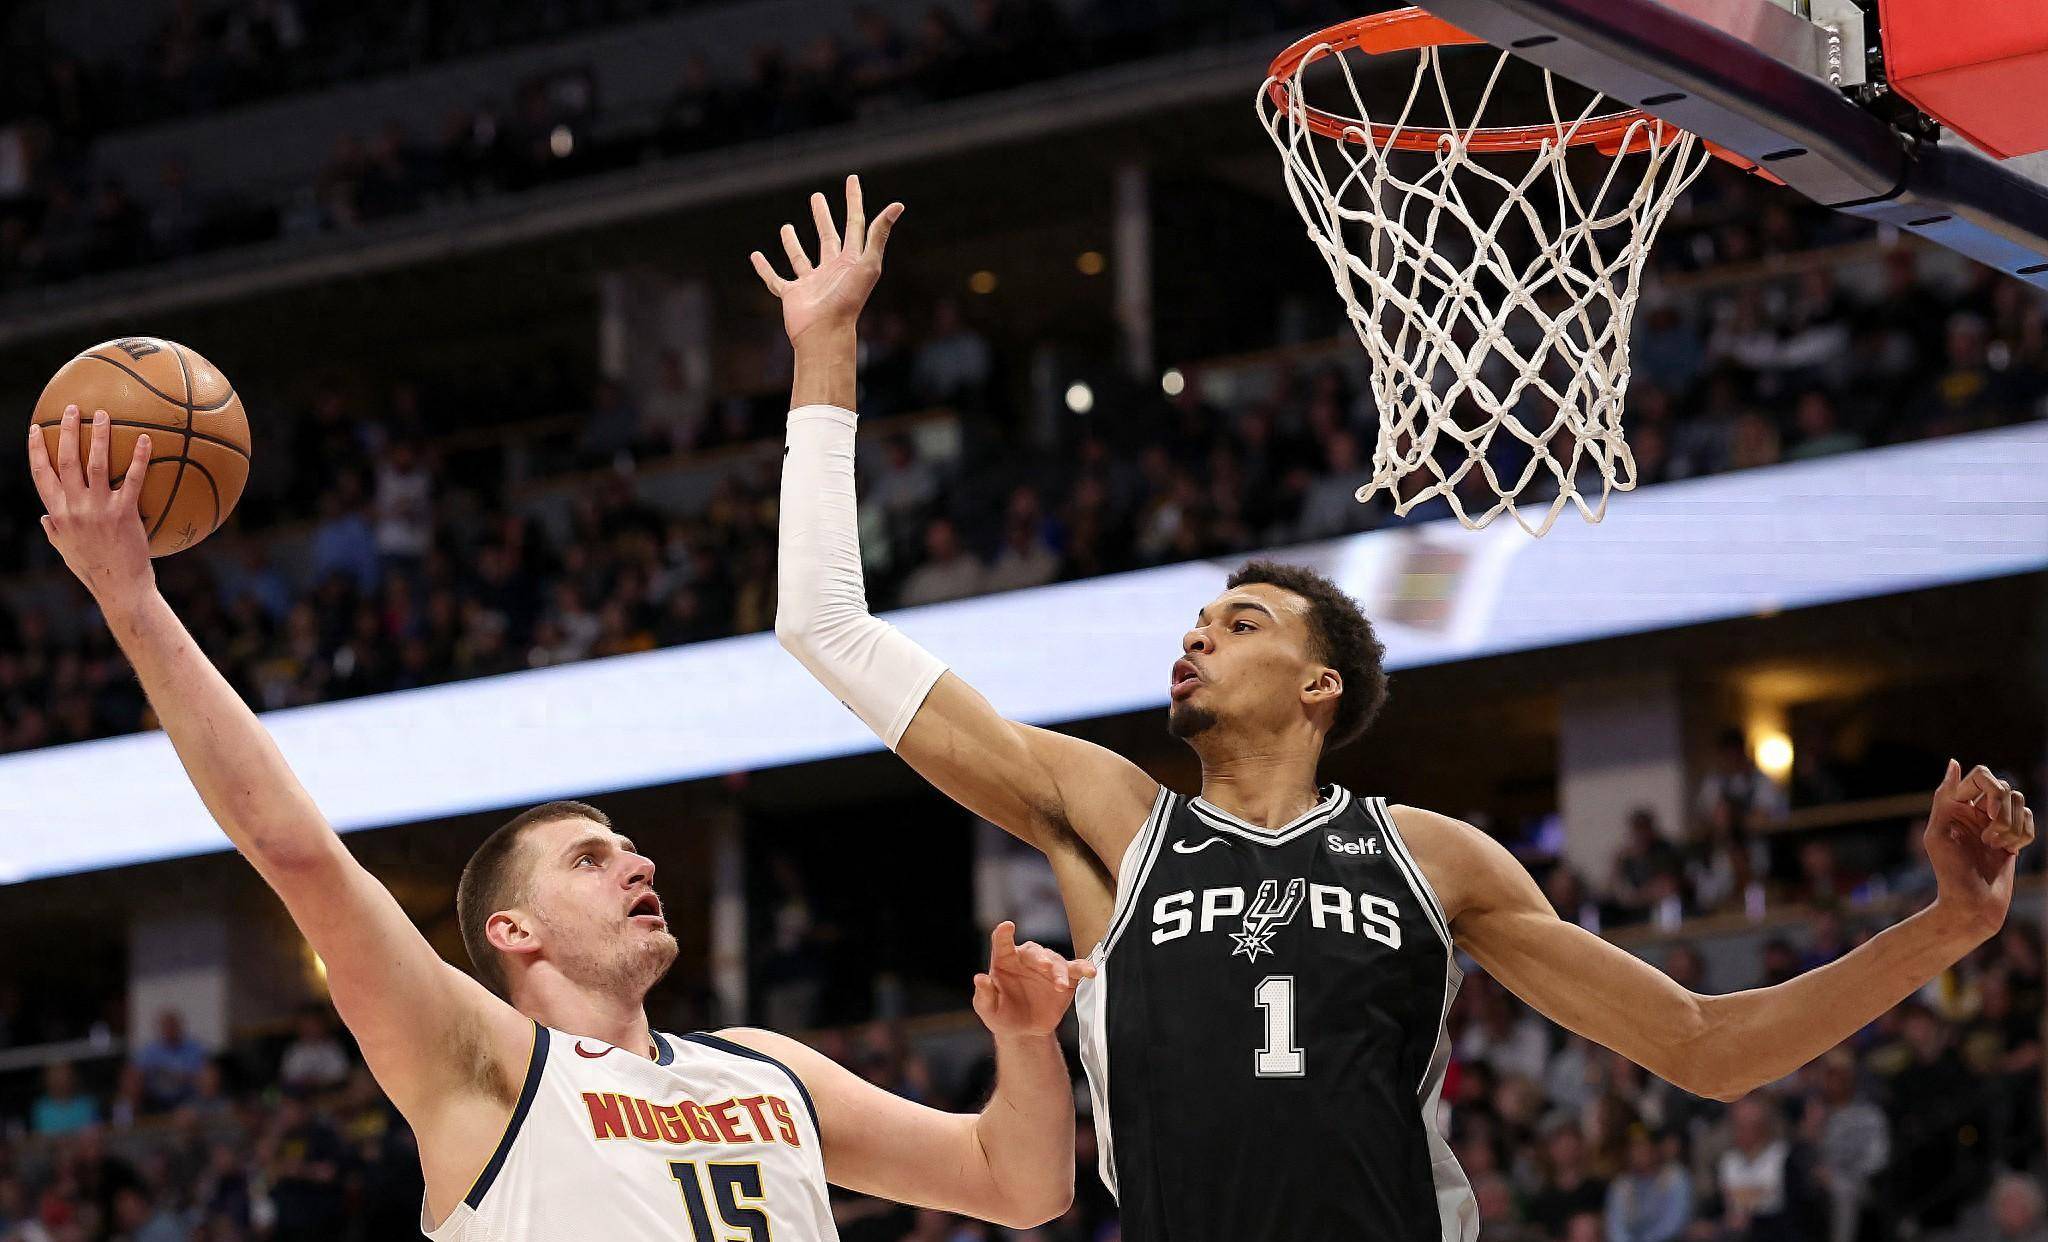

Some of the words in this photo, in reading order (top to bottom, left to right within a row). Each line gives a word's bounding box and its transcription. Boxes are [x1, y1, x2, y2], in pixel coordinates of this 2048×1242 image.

[1327, 834, 1382, 855] Self.
[1151, 878, 1402, 964] SPURS
[1254, 975, 1306, 1078] 1
[580, 1092, 801, 1149] NUGGETS
[666, 1159, 775, 1242] 15
